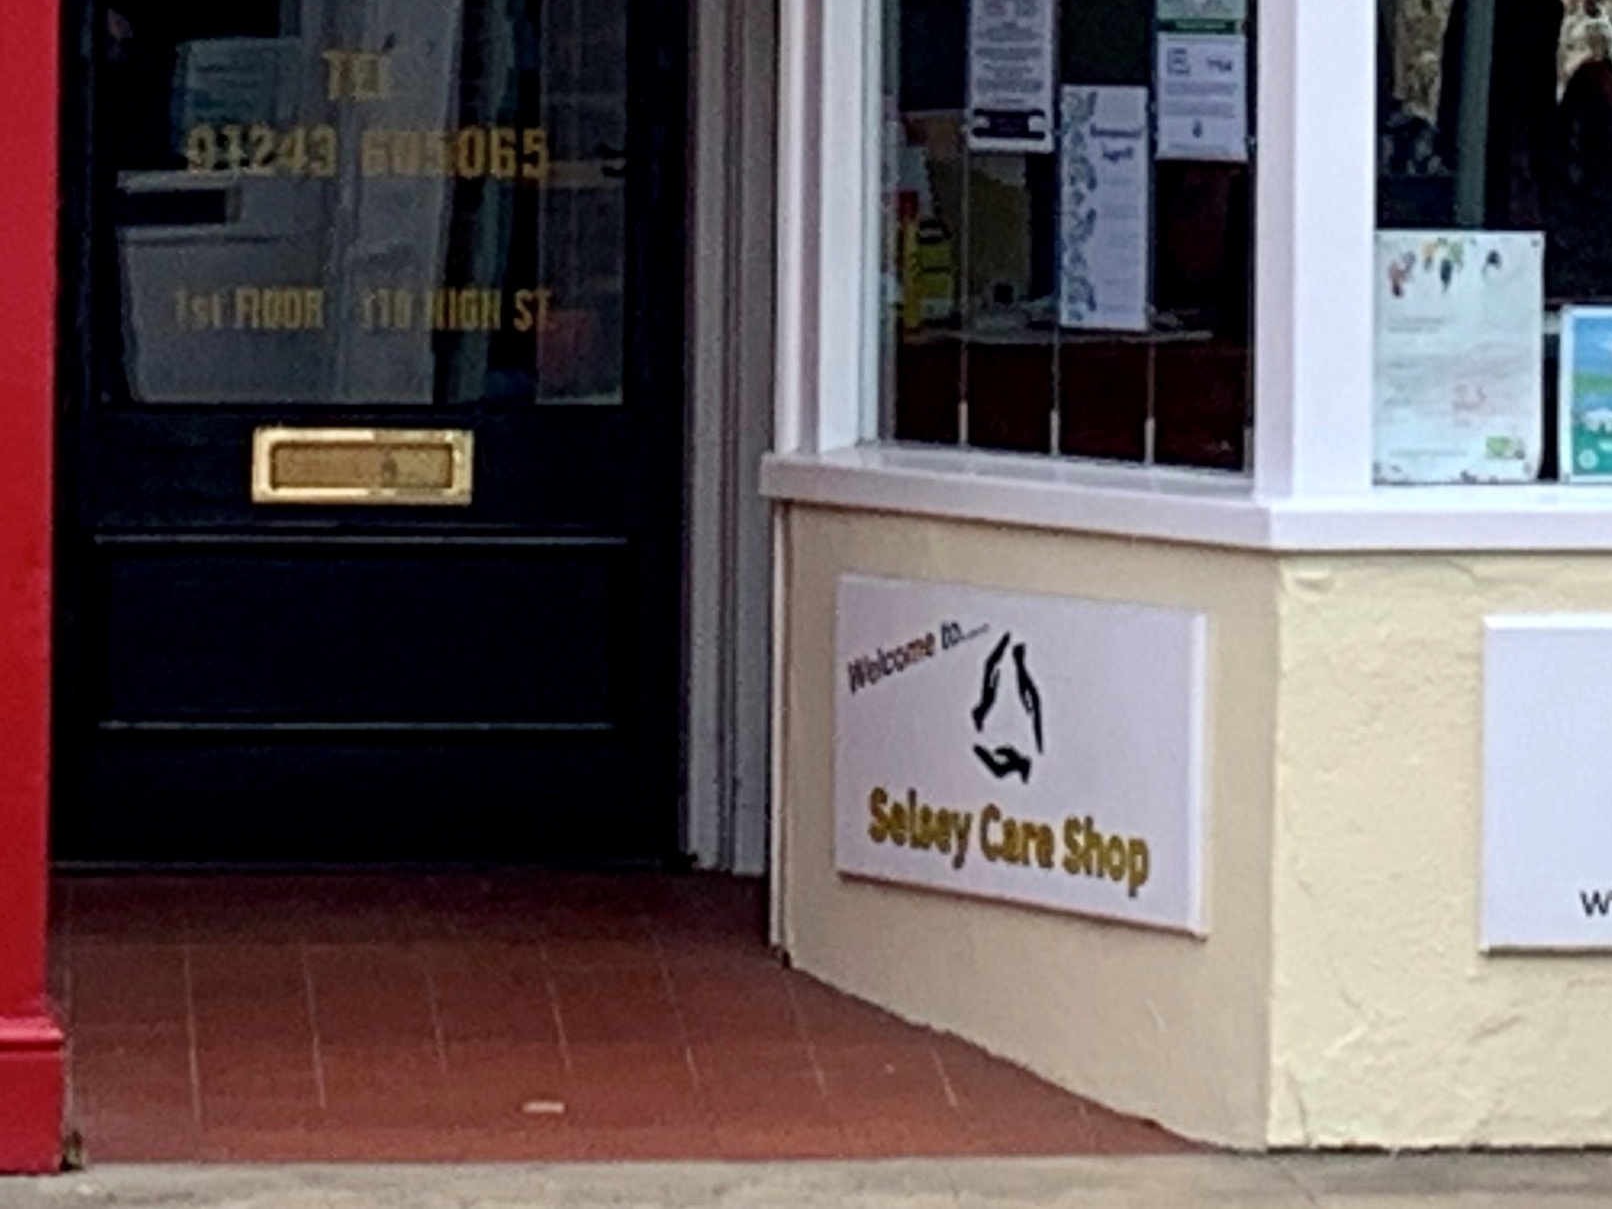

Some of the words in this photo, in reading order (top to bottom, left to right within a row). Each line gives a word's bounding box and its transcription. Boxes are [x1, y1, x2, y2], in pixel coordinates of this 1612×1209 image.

[848, 632, 936, 694] Welcome
[869, 786, 973, 871] Selsey
[979, 802, 1055, 870] Care
[1063, 814, 1150, 899] Shop
